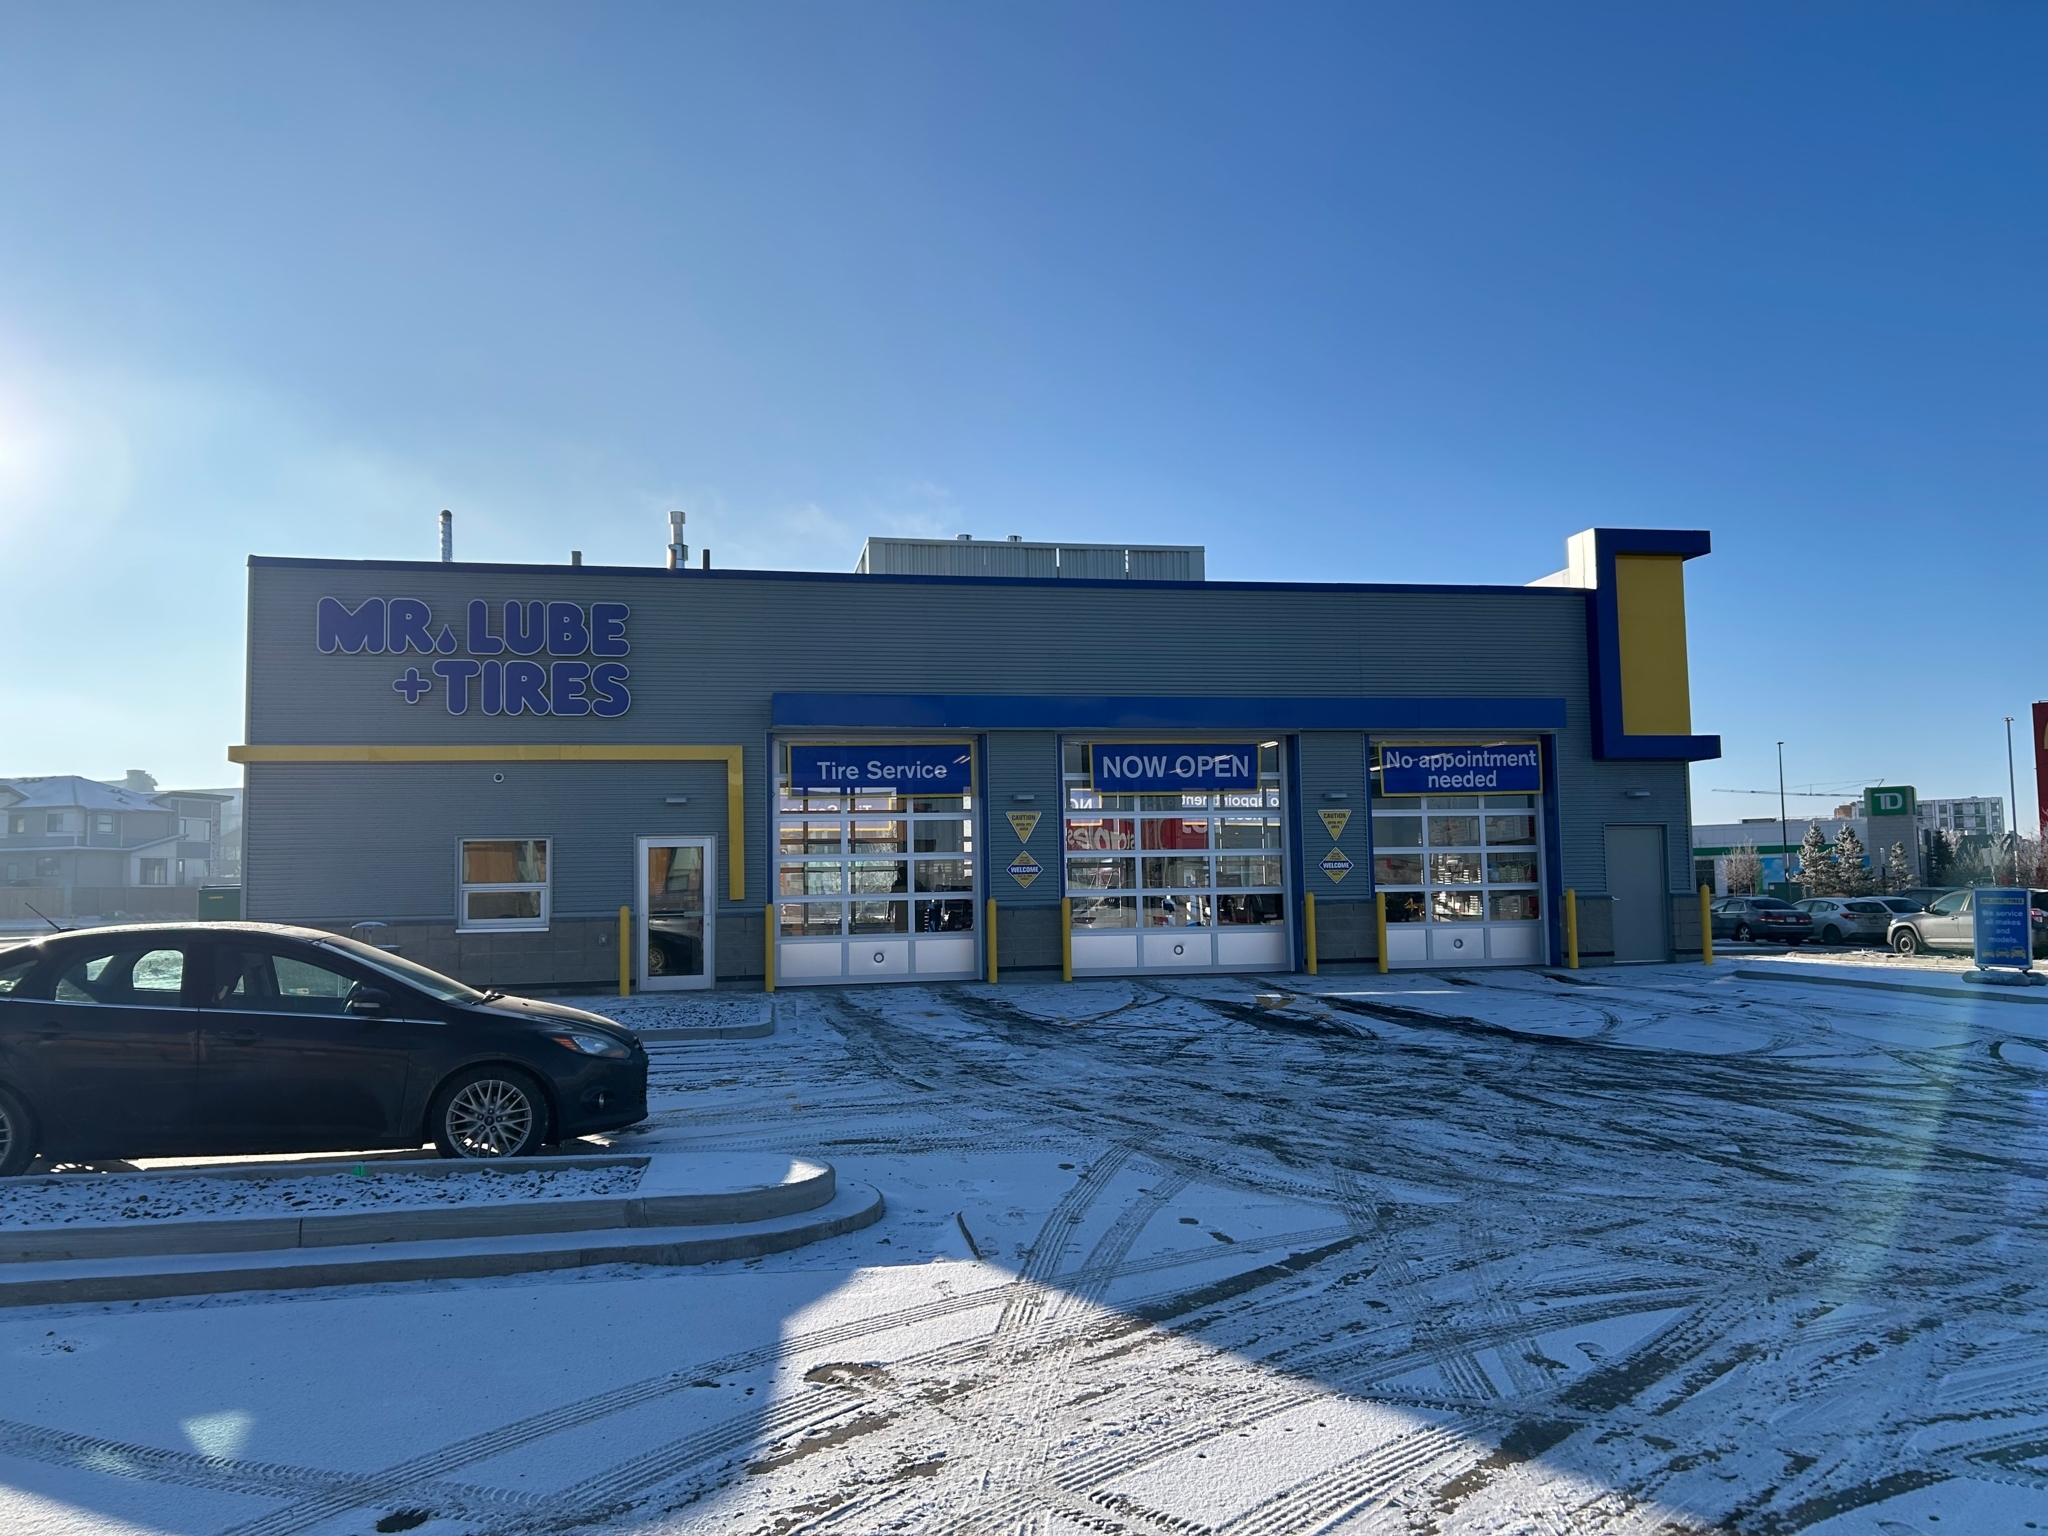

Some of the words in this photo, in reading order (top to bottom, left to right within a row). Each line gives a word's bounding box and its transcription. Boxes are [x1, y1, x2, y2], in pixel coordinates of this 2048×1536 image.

[467, 599, 631, 658] LUBE
[816, 761, 859, 780] Tire
[866, 760, 948, 780] Service
[1102, 755, 1167, 779] NOW
[1175, 755, 1249, 779] OPEN
[1386, 751, 1413, 769] No
[1418, 749, 1537, 771] appointment
[1428, 770, 1497, 788] needed
[1874, 793, 1903, 810] TD
